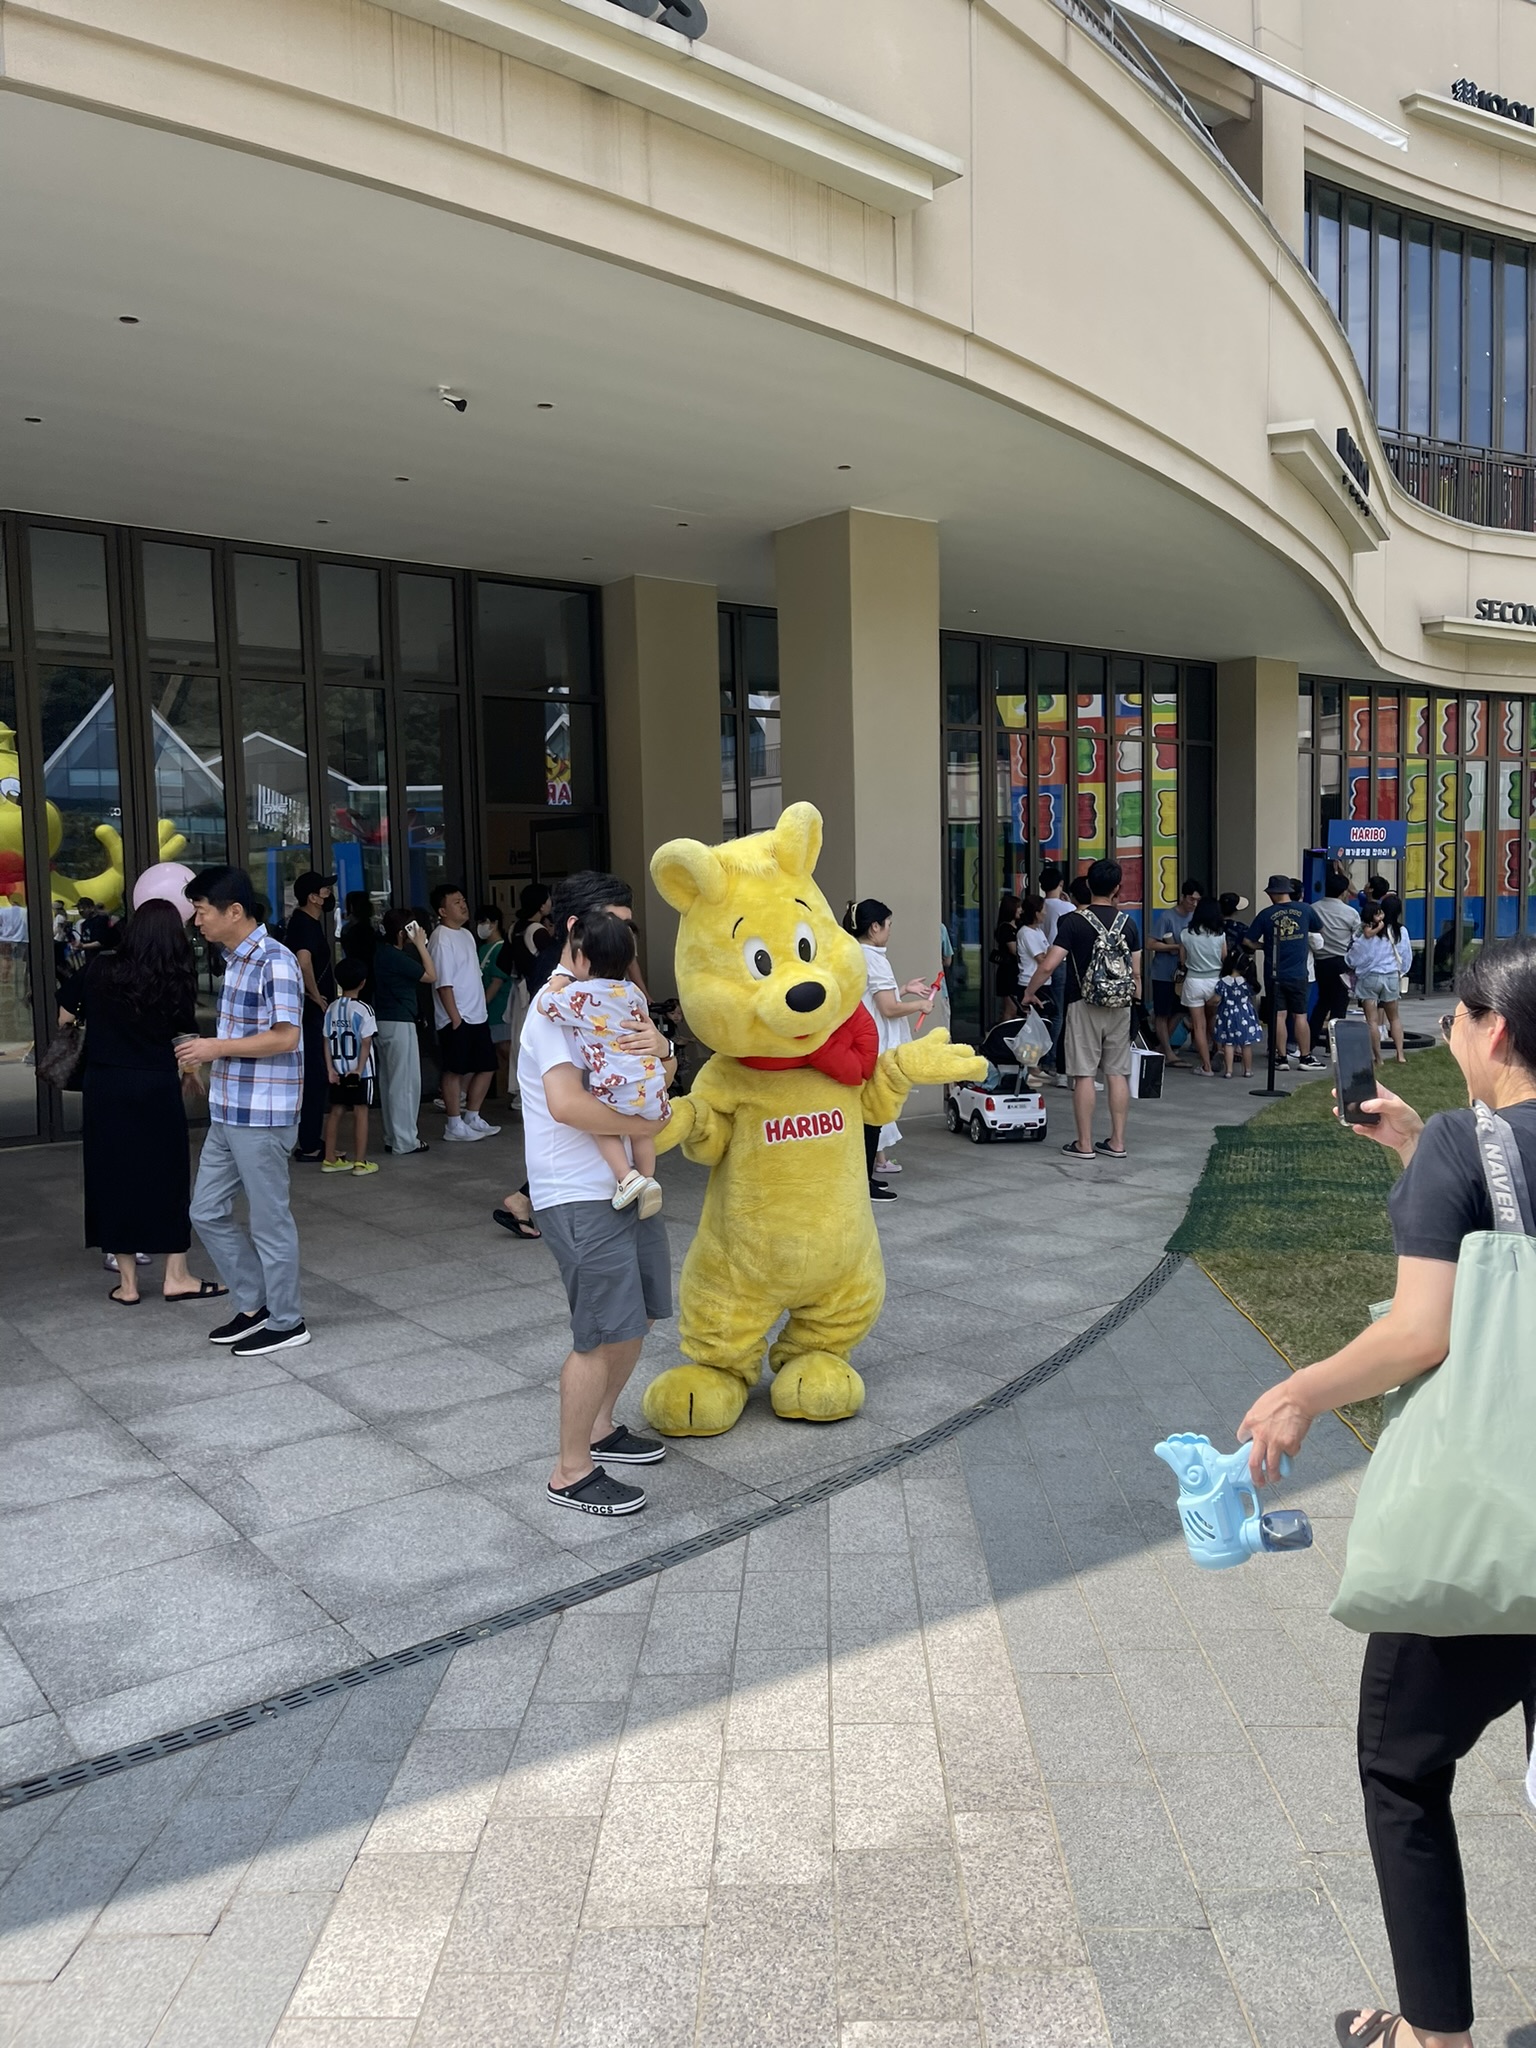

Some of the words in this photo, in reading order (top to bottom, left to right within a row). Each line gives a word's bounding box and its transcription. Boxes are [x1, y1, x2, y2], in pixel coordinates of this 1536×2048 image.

[1351, 828, 1386, 841] HARIBO
[329, 1031, 357, 1060] 10
[764, 1109, 844, 1143] HARIBO
[1484, 1143, 1516, 1223] NAVER
[580, 1503, 614, 1514] crocs
